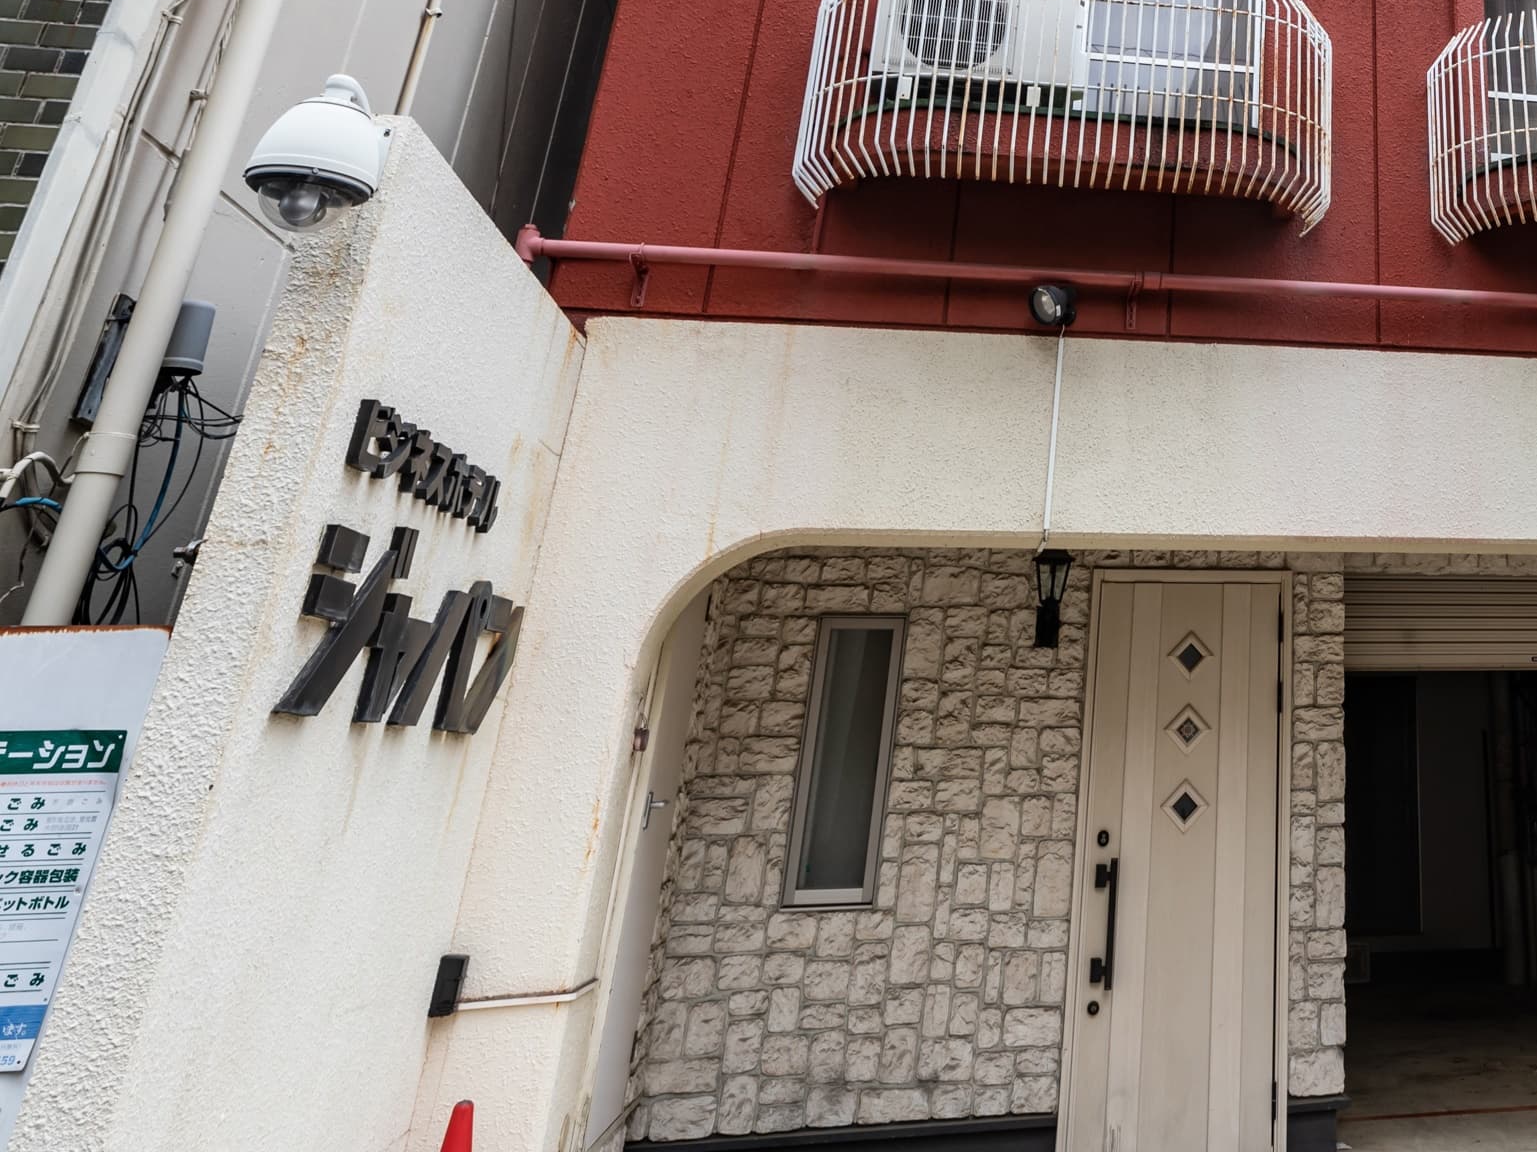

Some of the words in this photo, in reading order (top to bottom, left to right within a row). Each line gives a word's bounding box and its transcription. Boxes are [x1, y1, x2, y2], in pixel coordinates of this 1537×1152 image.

[271, 524, 525, 735] ジャパン
[0, 868, 80, 885] ク容器包装
[0, 895, 70, 912] ットボトル
